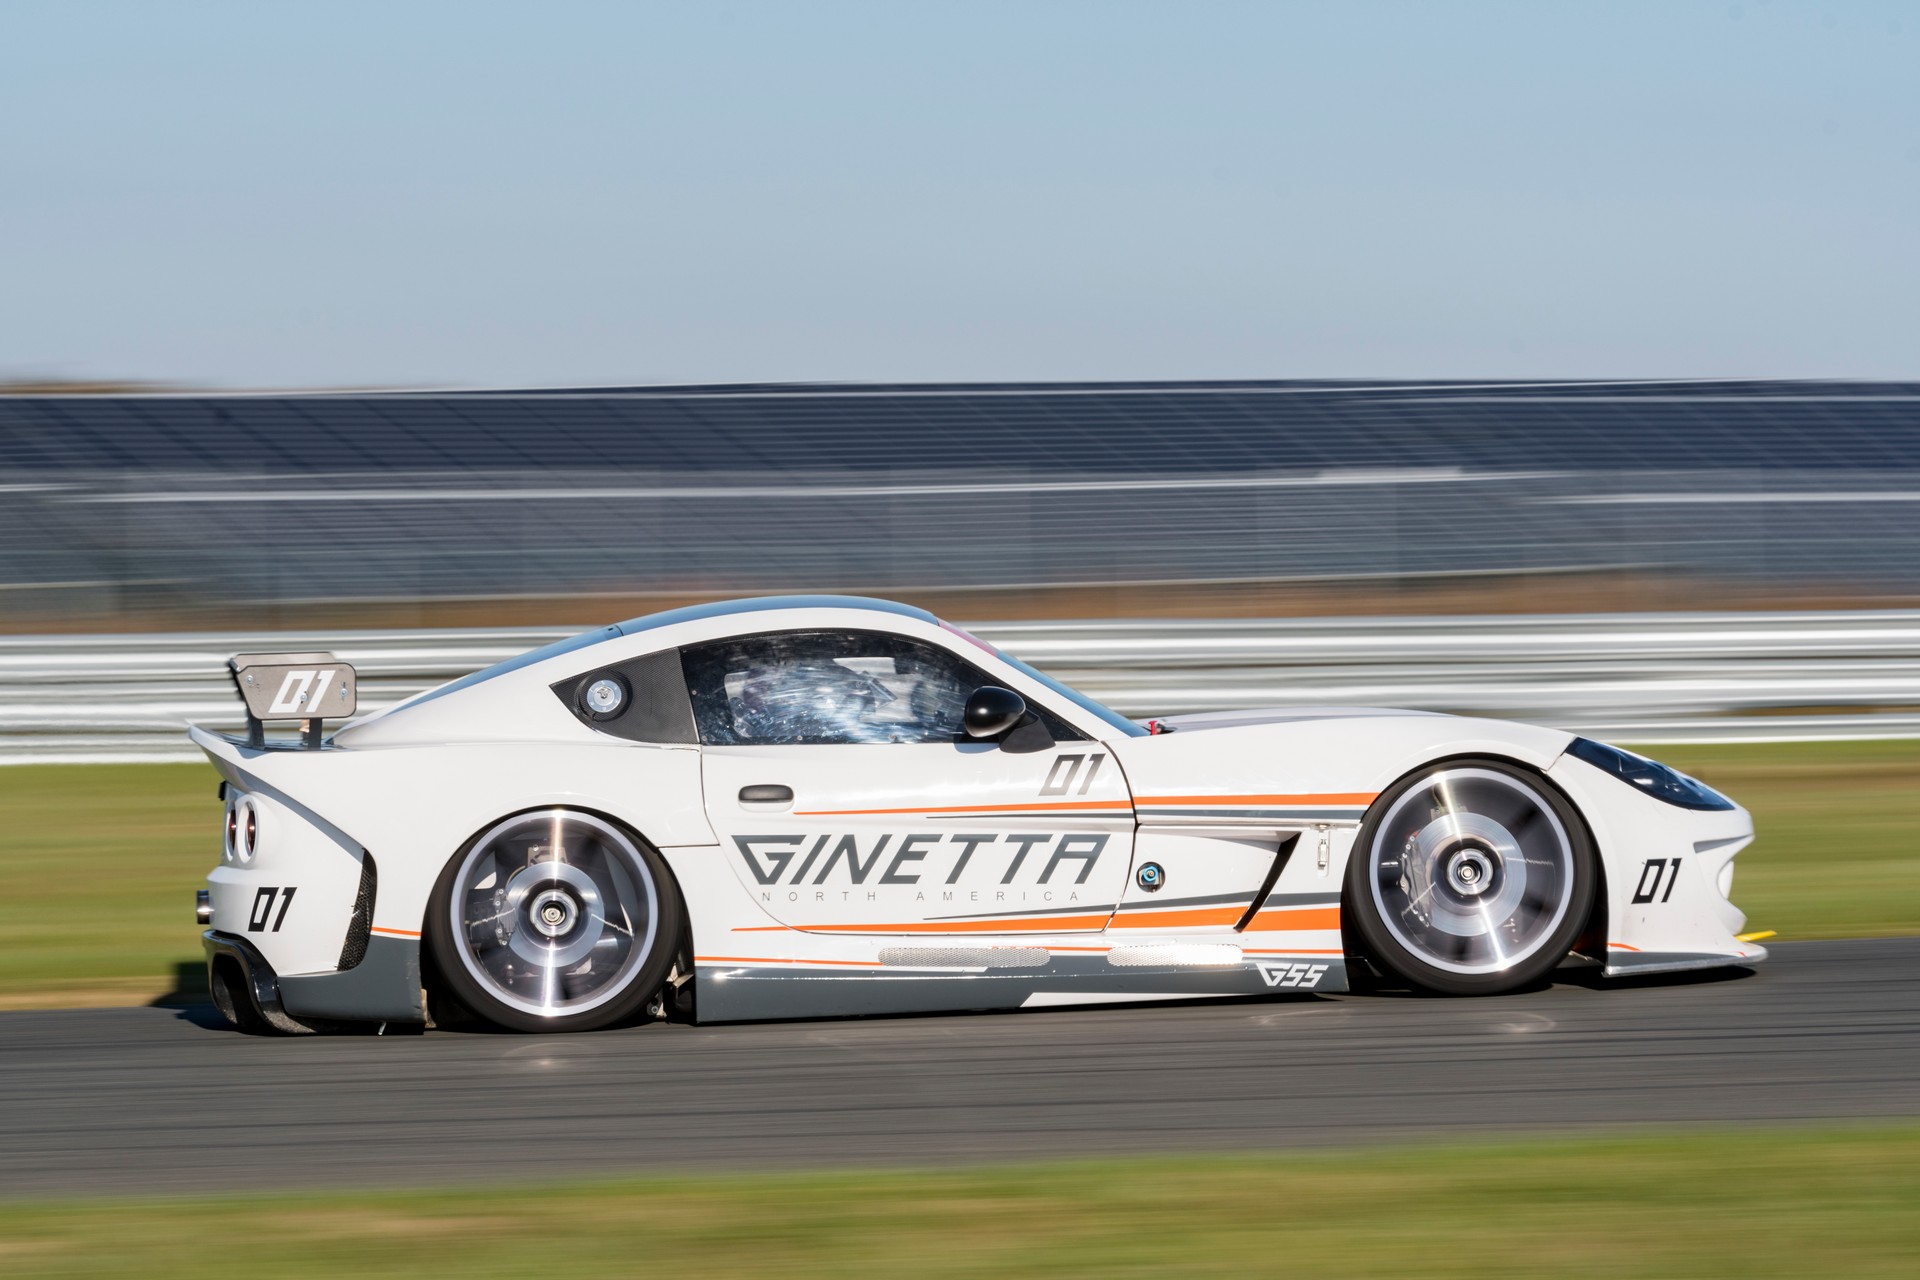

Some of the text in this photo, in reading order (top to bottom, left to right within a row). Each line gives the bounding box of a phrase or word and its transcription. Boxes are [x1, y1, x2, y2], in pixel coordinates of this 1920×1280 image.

[268, 670, 336, 713] 01
[1038, 753, 1106, 796] 01
[731, 834, 1110, 885] GINETTA
[1631, 858, 1682, 904] 01
[248, 887, 297, 932] 01
[762, 891, 1078, 902] NORTH AMERICA
